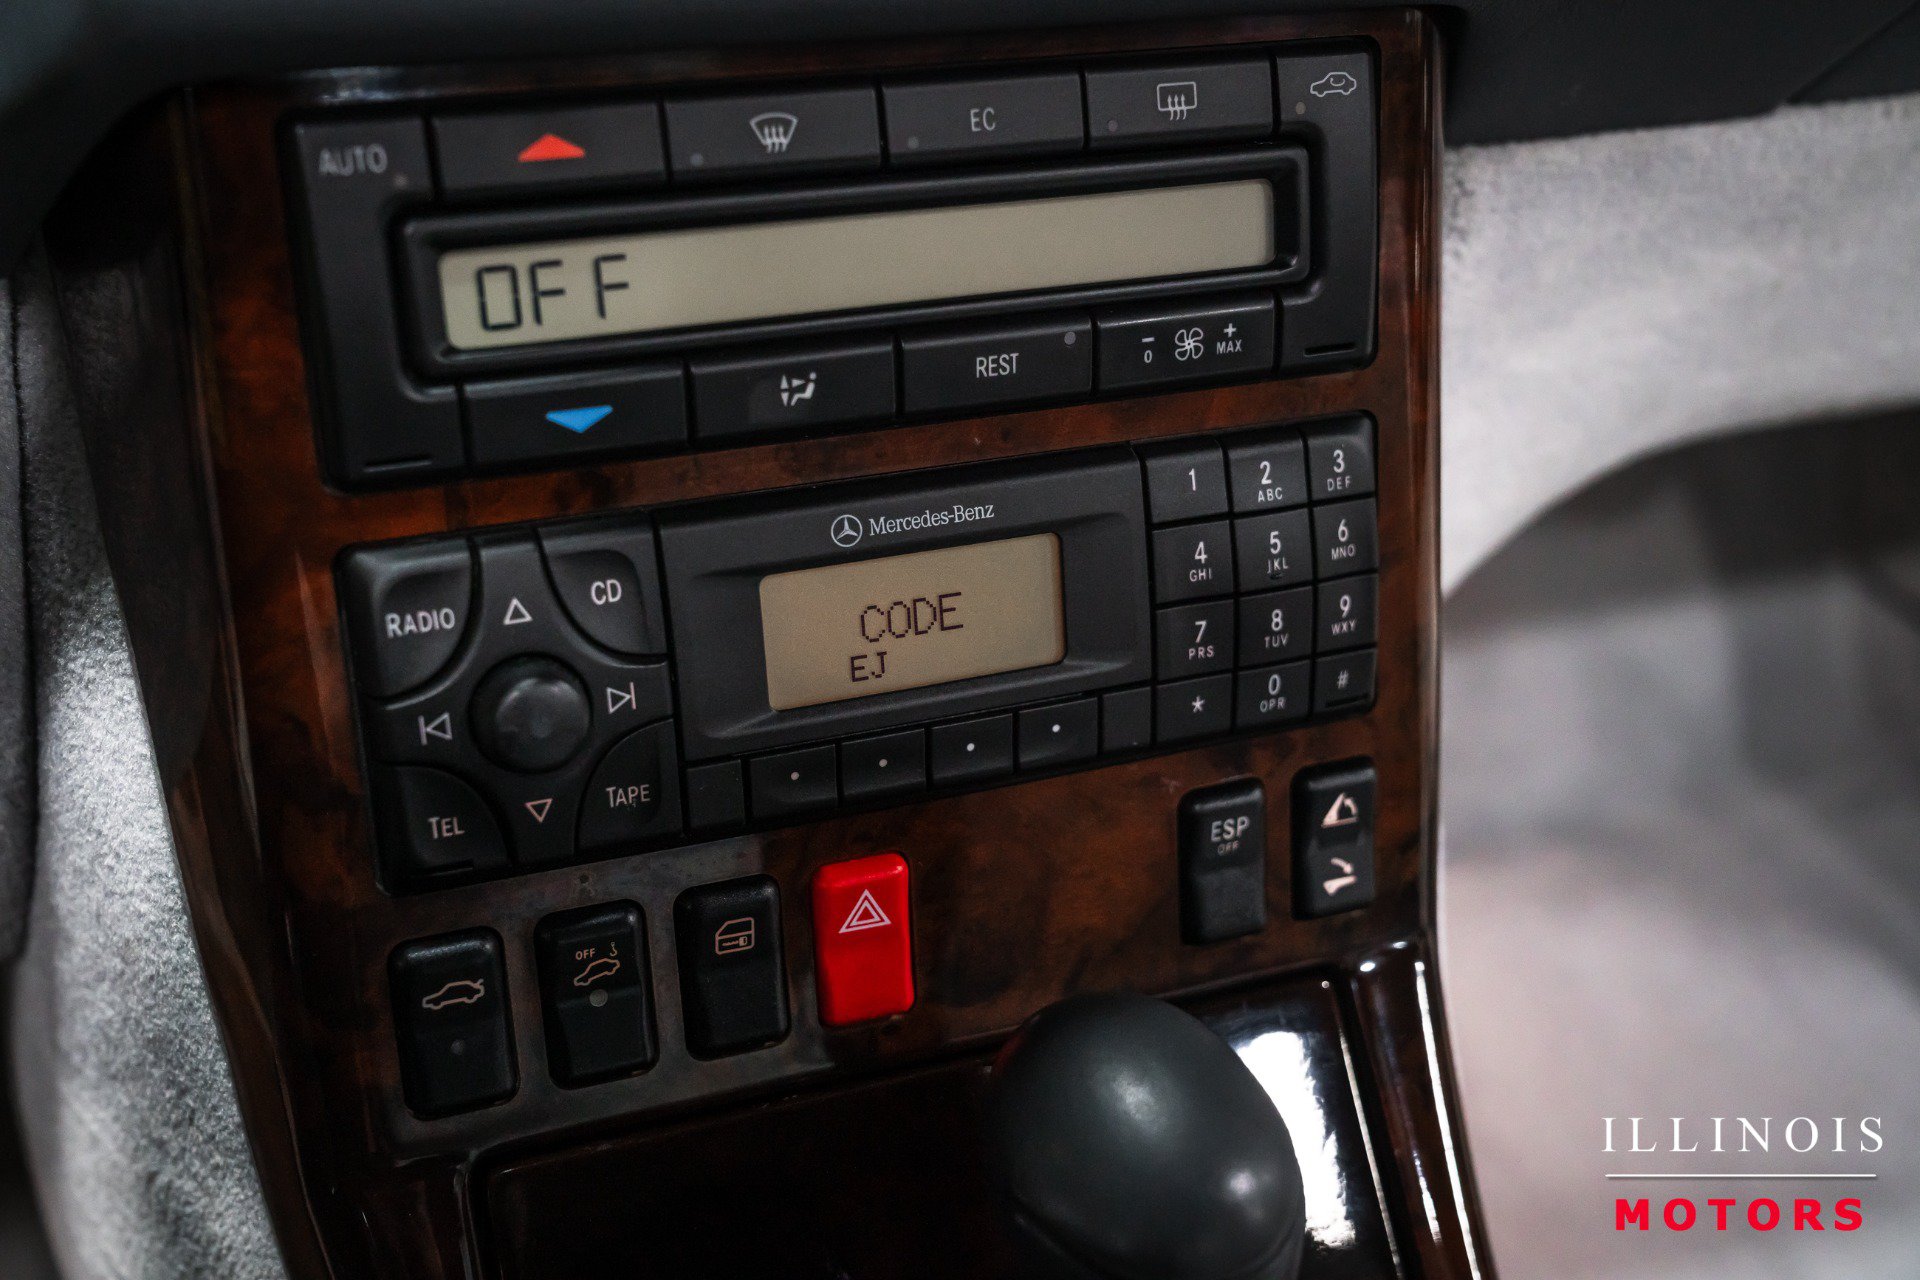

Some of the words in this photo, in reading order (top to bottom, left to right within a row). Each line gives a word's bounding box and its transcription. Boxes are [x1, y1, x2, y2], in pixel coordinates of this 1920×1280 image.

[970, 108, 996, 132] EC
[318, 143, 388, 176] AUTO
[1216, 338, 1243, 354] MAX
[976, 353, 1019, 378] REST
[1259, 461, 1272, 485] 2
[1333, 449, 1346, 474] 3
[1188, 468, 1197, 492] 1
[1327, 476, 1351, 491] DEF
[1257, 487, 1283, 503] ABC
[869, 503, 995, 537] Mercedes-Benz
[1337, 518, 1349, 542] 6
[1194, 541, 1208, 564] 4
[1269, 531, 1282, 555] 5
[1331, 544, 1356, 560] MNO
[1189, 568, 1212, 582] GHI
[1266, 557, 1289, 574] JKL
[590, 579, 622, 606] CD
[860, 592, 964, 643] CODE
[1339, 594, 1352, 618] 9
[385, 608, 456, 638] RADIO
[1194, 620, 1208, 644] 7
[1270, 608, 1283, 632] 8
[1331, 619, 1358, 636] WXY
[1188, 645, 1215, 660] PRS
[1264, 634, 1289, 649] TUV
[850, 651, 888, 682] EJ
[1268, 673, 1282, 696] 0
[1259, 696, 1287, 713] OPR
[606, 784, 651, 808] TAPE
[428, 816, 465, 839] TEL
[1211, 815, 1250, 842] ESP
[1217, 840, 1239, 856] OFF
[575, 947, 596, 961] OFF
